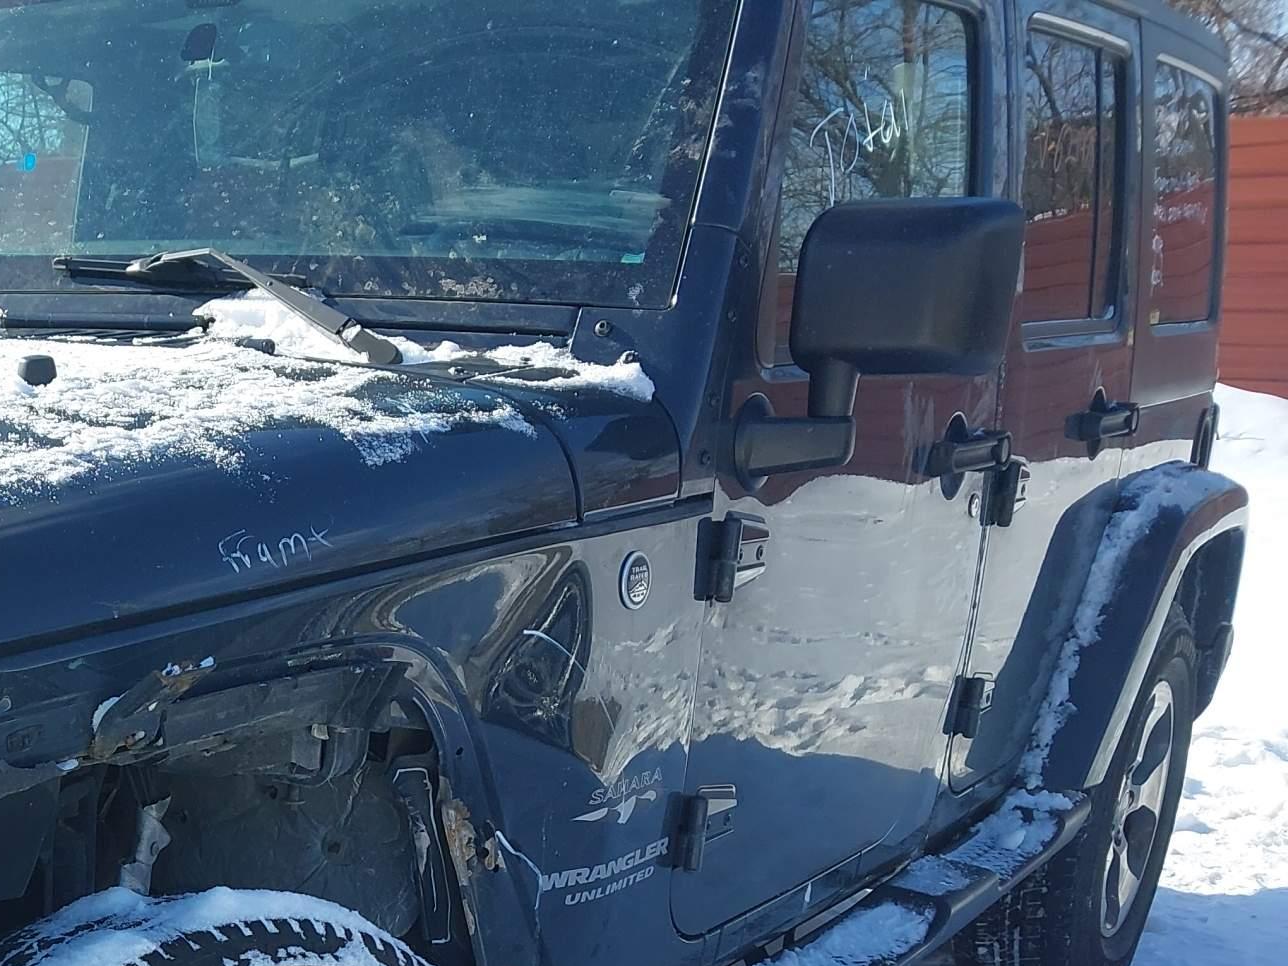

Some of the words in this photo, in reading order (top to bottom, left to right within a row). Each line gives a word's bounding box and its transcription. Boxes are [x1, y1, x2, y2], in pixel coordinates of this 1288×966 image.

[588, 767, 663, 806] SAHARA
[542, 836, 669, 891] WRANGLER
[564, 865, 655, 906] UNLIMITED
